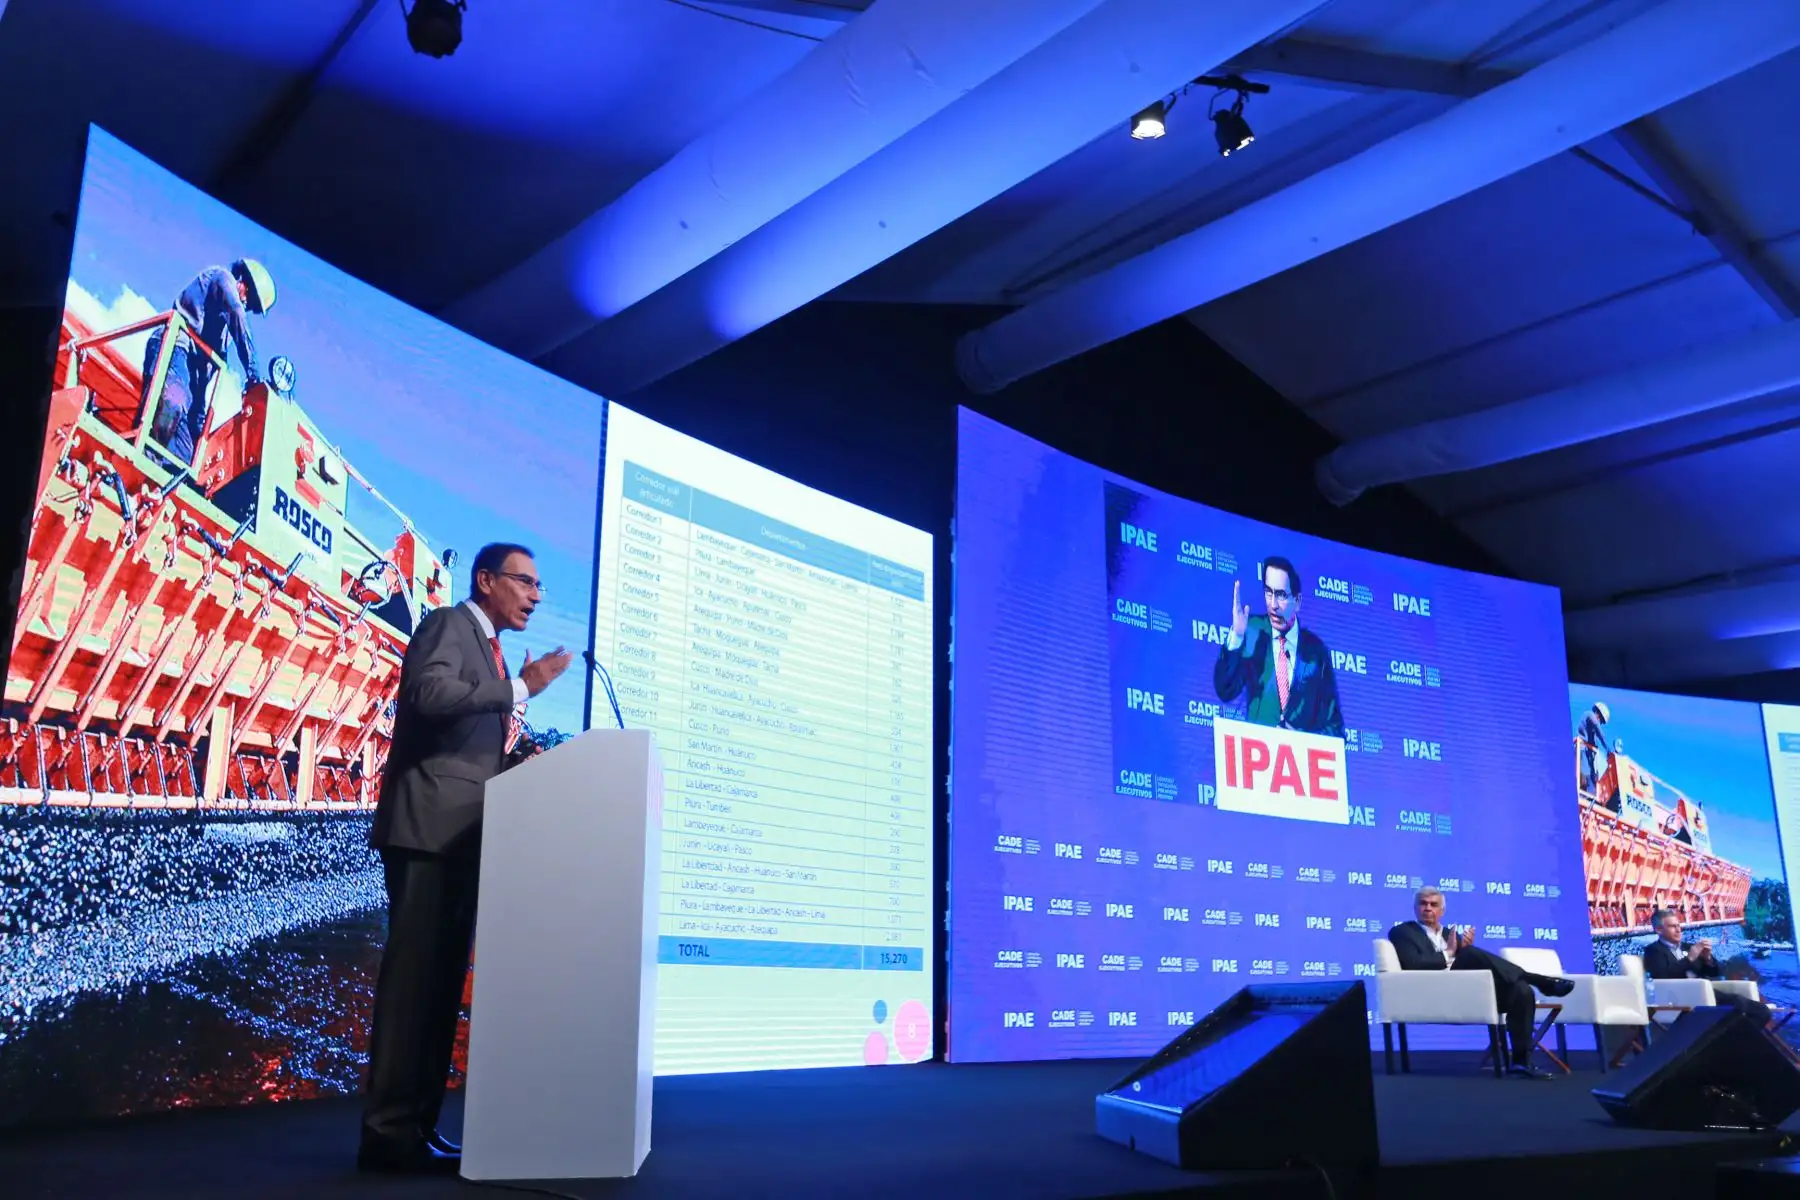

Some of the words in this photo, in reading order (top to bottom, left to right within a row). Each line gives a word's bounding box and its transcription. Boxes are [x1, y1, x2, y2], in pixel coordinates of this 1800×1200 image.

[272, 485, 332, 554] ROSCO
[1120, 522, 1158, 552] IPAE
[1181, 540, 1212, 560] CADE
[1176, 554, 1212, 570] EJECUTIVOS
[1318, 576, 1348, 594] CADE
[1314, 588, 1349, 603] EJECUTIVOS
[1116, 598, 1147, 618] CADE
[1393, 592, 1430, 616] IPAE
[1112, 614, 1147, 628] EJECUTIVOS
[1331, 650, 1366, 674] IPAE
[1391, 660, 1421, 676] CADE
[616, 682, 648, 700] Corredor
[1127, 688, 1164, 715] IPAE
[1188, 700, 1220, 718] CADE
[1184, 715, 1214, 727] EJECUTIV
[1404, 738, 1441, 761] IPAE
[1224, 734, 1338, 801] IPAE
[1120, 770, 1152, 788] CADE
[1116, 786, 1152, 798] EJECUTIVOS
[1400, 810, 1431, 826] CADE
[998, 835, 1022, 848] CADE
[1055, 843, 1082, 859] IPAE
[1099, 847, 1122, 858] CADE
[1156, 854, 1177, 864] CADE
[1208, 860, 1232, 874] IPAE
[1248, 862, 1268, 872] CADE
[1299, 867, 1320, 878] CADE
[1348, 872, 1372, 886] IPAE
[1386, 874, 1406, 884] CADE
[1440, 878, 1460, 888] CADE
[1486, 882, 1511, 895] IPAE
[1526, 884, 1545, 894] CADE
[1004, 896, 1033, 912] IPAE
[1050, 898, 1073, 910] CADE
[1106, 903, 1133, 918] IPAE
[1164, 907, 1189, 922] IPAE
[1205, 909, 1226, 920] CADE
[1255, 914, 1280, 927] IPAE
[1306, 916, 1332, 930] IPAE
[1346, 918, 1366, 928] CADE
[1486, 925, 1506, 936] CADE
[1534, 928, 1558, 940] IPAE
[679, 943, 710, 958] TOTAL
[880, 953, 908, 966] 15,270
[998, 950, 1022, 962] CADE
[1056, 954, 1084, 968] IPAE
[1102, 955, 1124, 965] CADE
[1160, 957, 1182, 967] CADE
[1212, 959, 1238, 972] IPAE
[1252, 960, 1272, 970] CADE
[1304, 962, 1324, 972] CADE
[1004, 1012, 1034, 1028] IPAE
[1052, 1010, 1075, 1022] CADE
[1109, 1012, 1136, 1026] IPAE
[1168, 1012, 1194, 1026] IPAE
